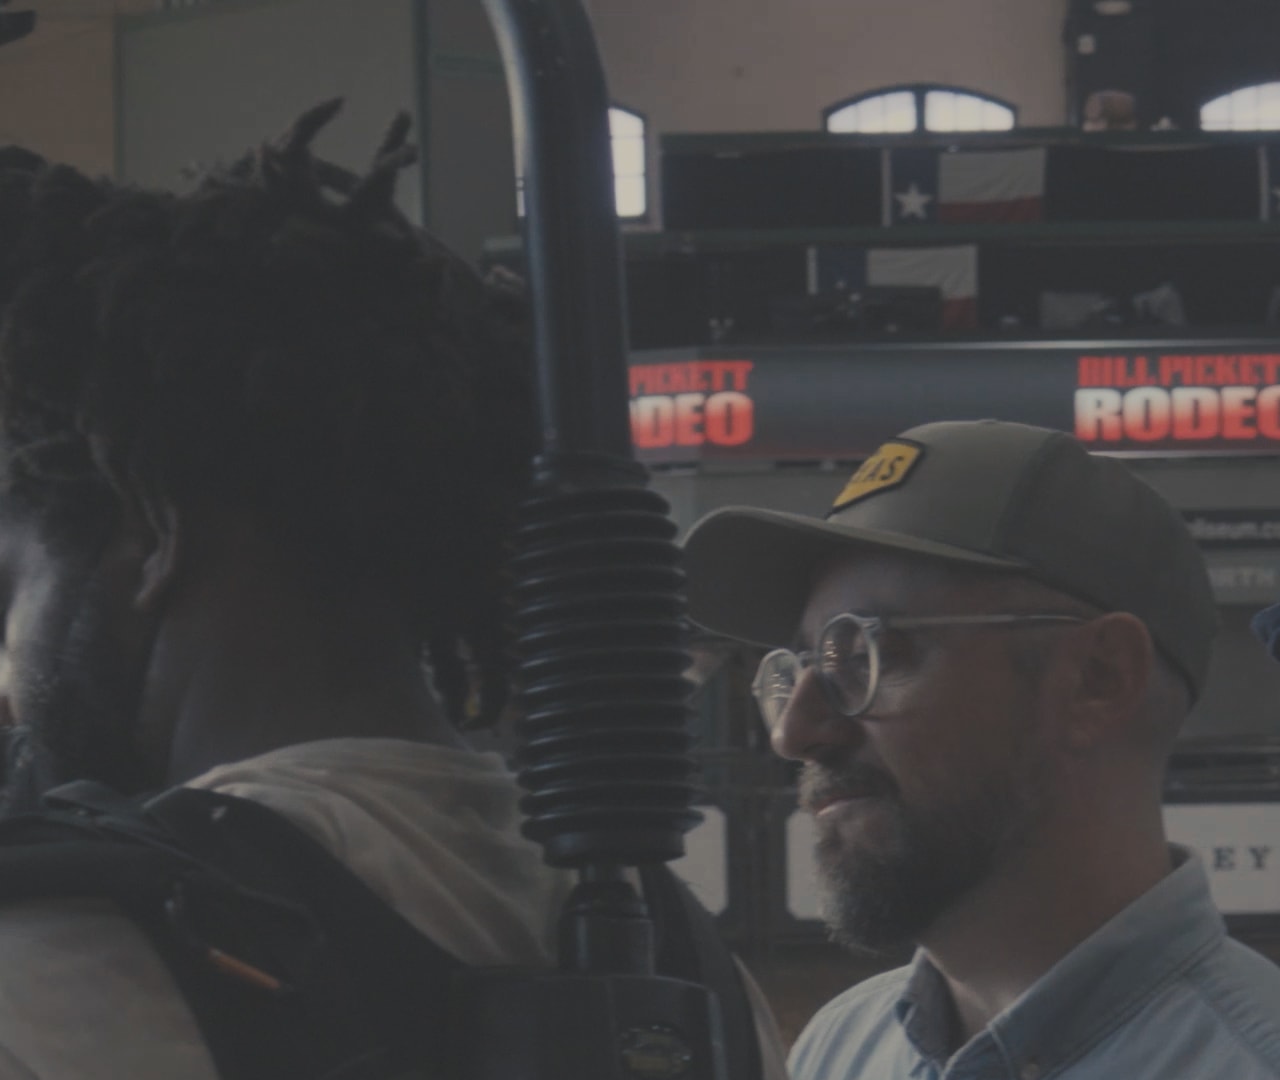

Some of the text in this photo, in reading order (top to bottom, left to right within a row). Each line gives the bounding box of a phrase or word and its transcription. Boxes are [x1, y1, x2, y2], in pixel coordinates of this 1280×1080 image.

[1078, 355, 1156, 388] BILL
[629, 391, 754, 448] DEO
[1214, 845, 1272, 871] EY
